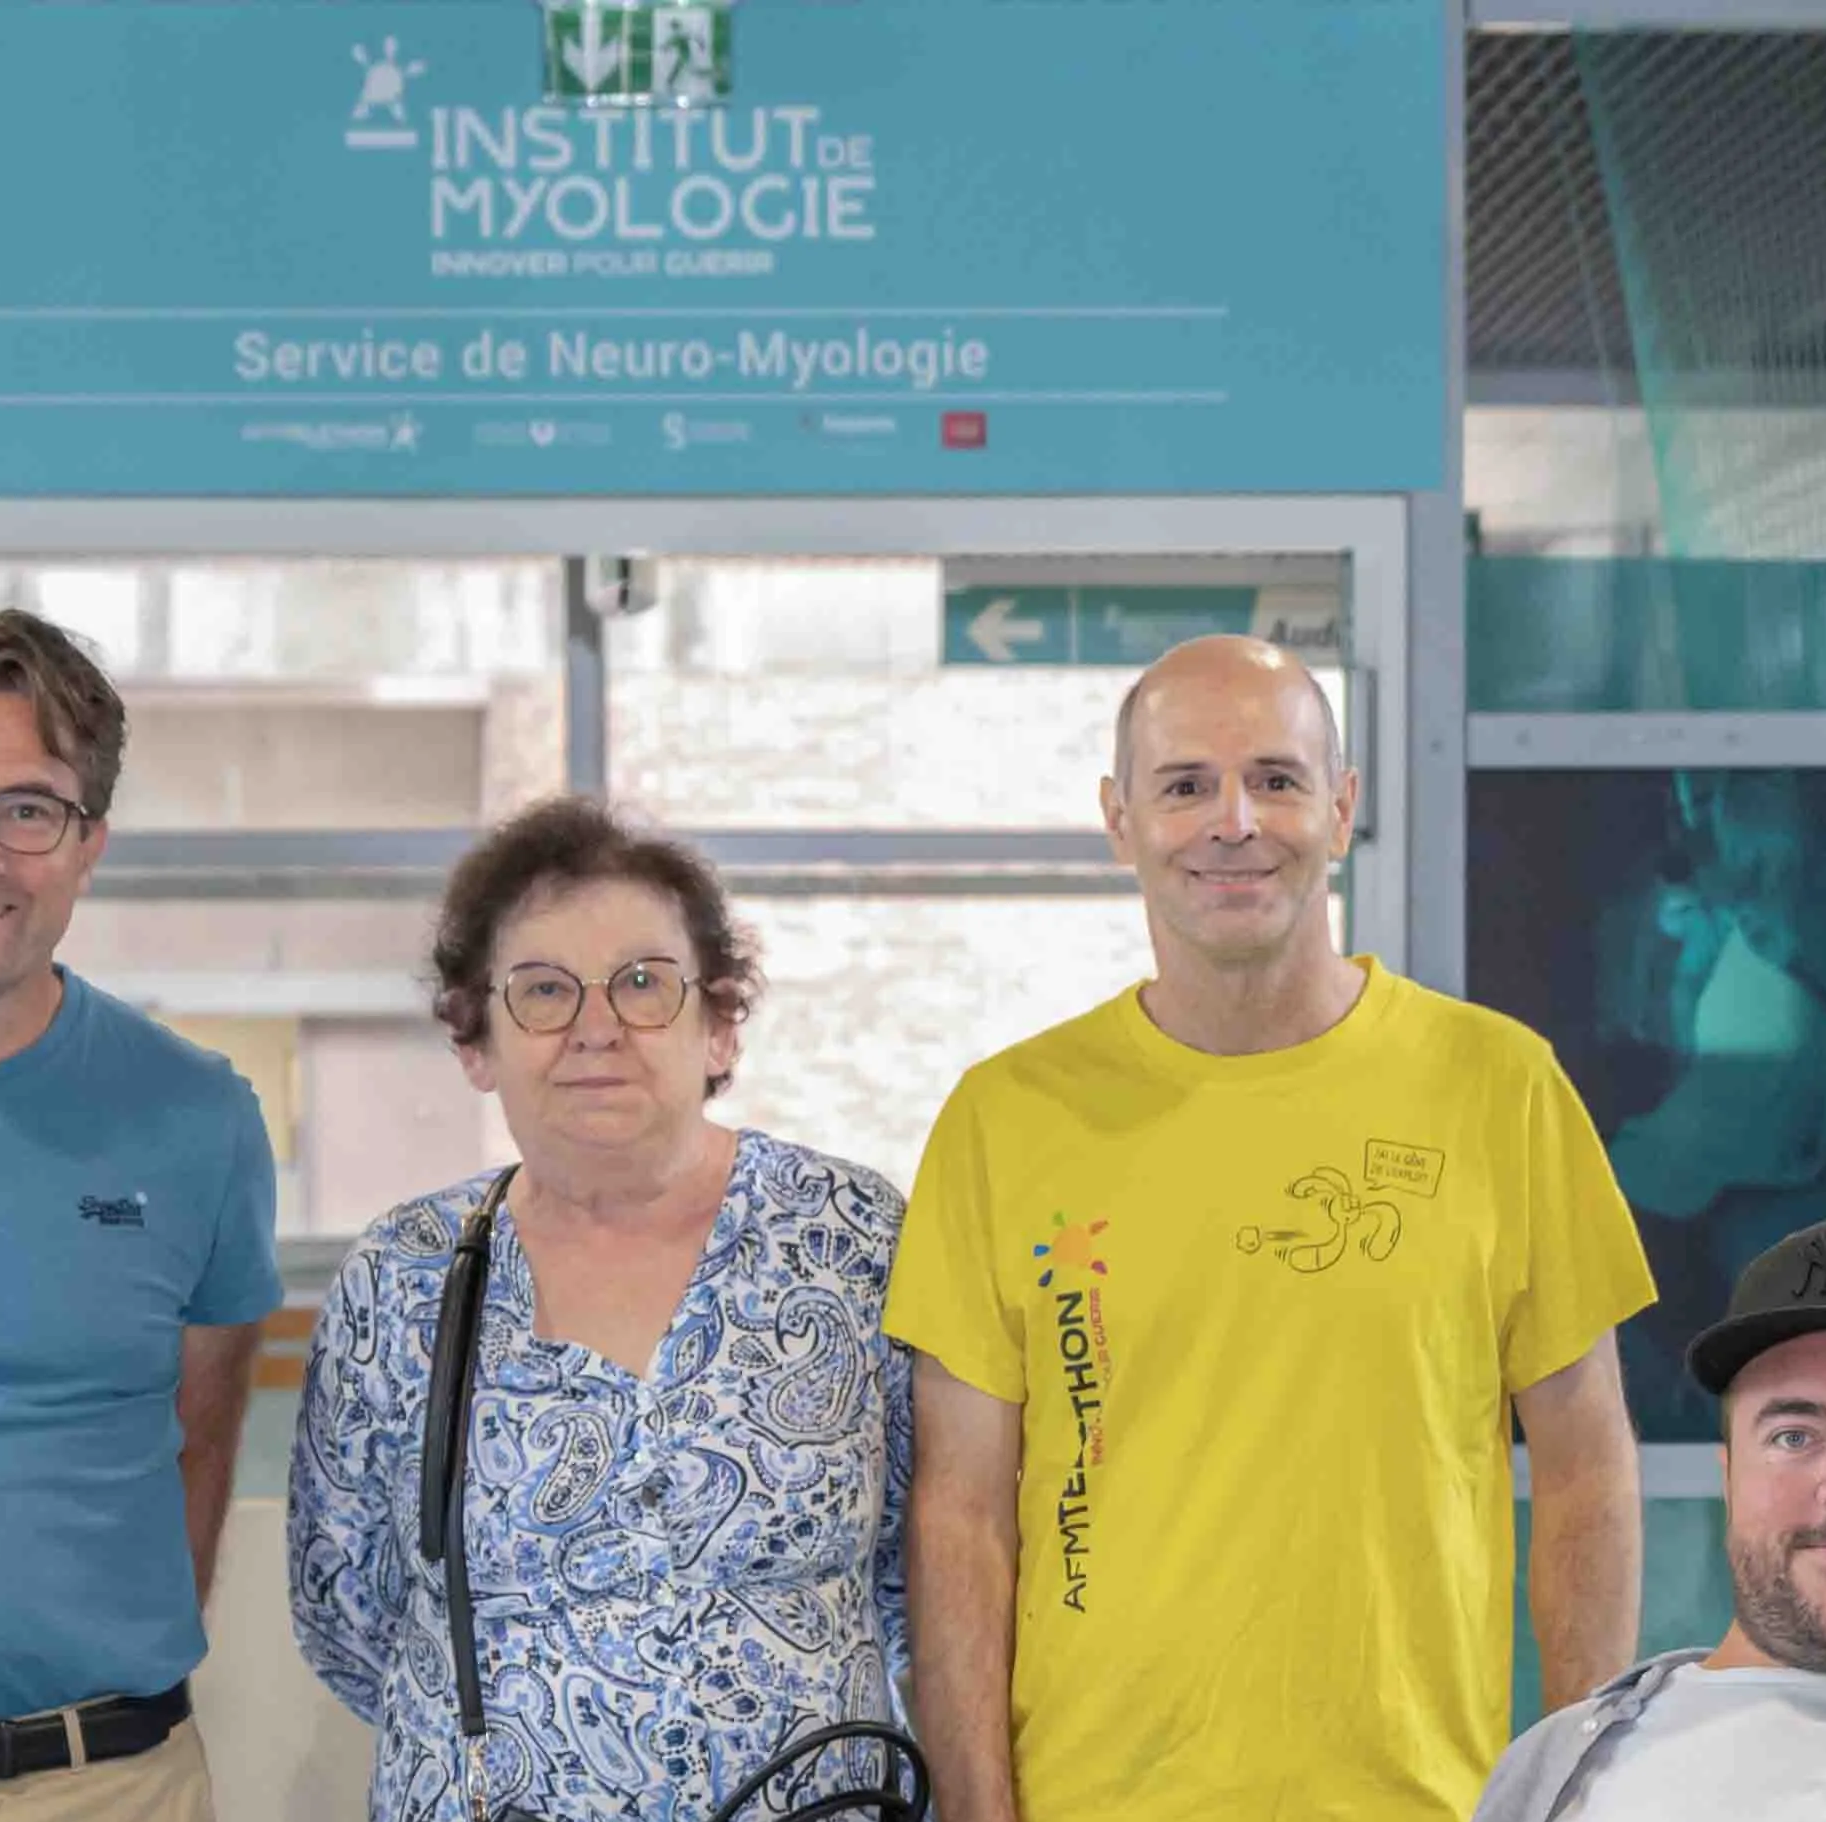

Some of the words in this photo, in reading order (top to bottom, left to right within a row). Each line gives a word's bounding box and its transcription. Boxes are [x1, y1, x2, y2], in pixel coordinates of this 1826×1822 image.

[431, 106, 820, 170] INSTITUT
[817, 136, 873, 168] DE
[430, 176, 875, 240] MYOLOGIE
[430, 250, 567, 276] INNOVER
[574, 250, 658, 276] POUR
[234, 327, 441, 381] Service
[463, 327, 527, 380] de
[548, 323, 989, 390] Neuro-Myologie
